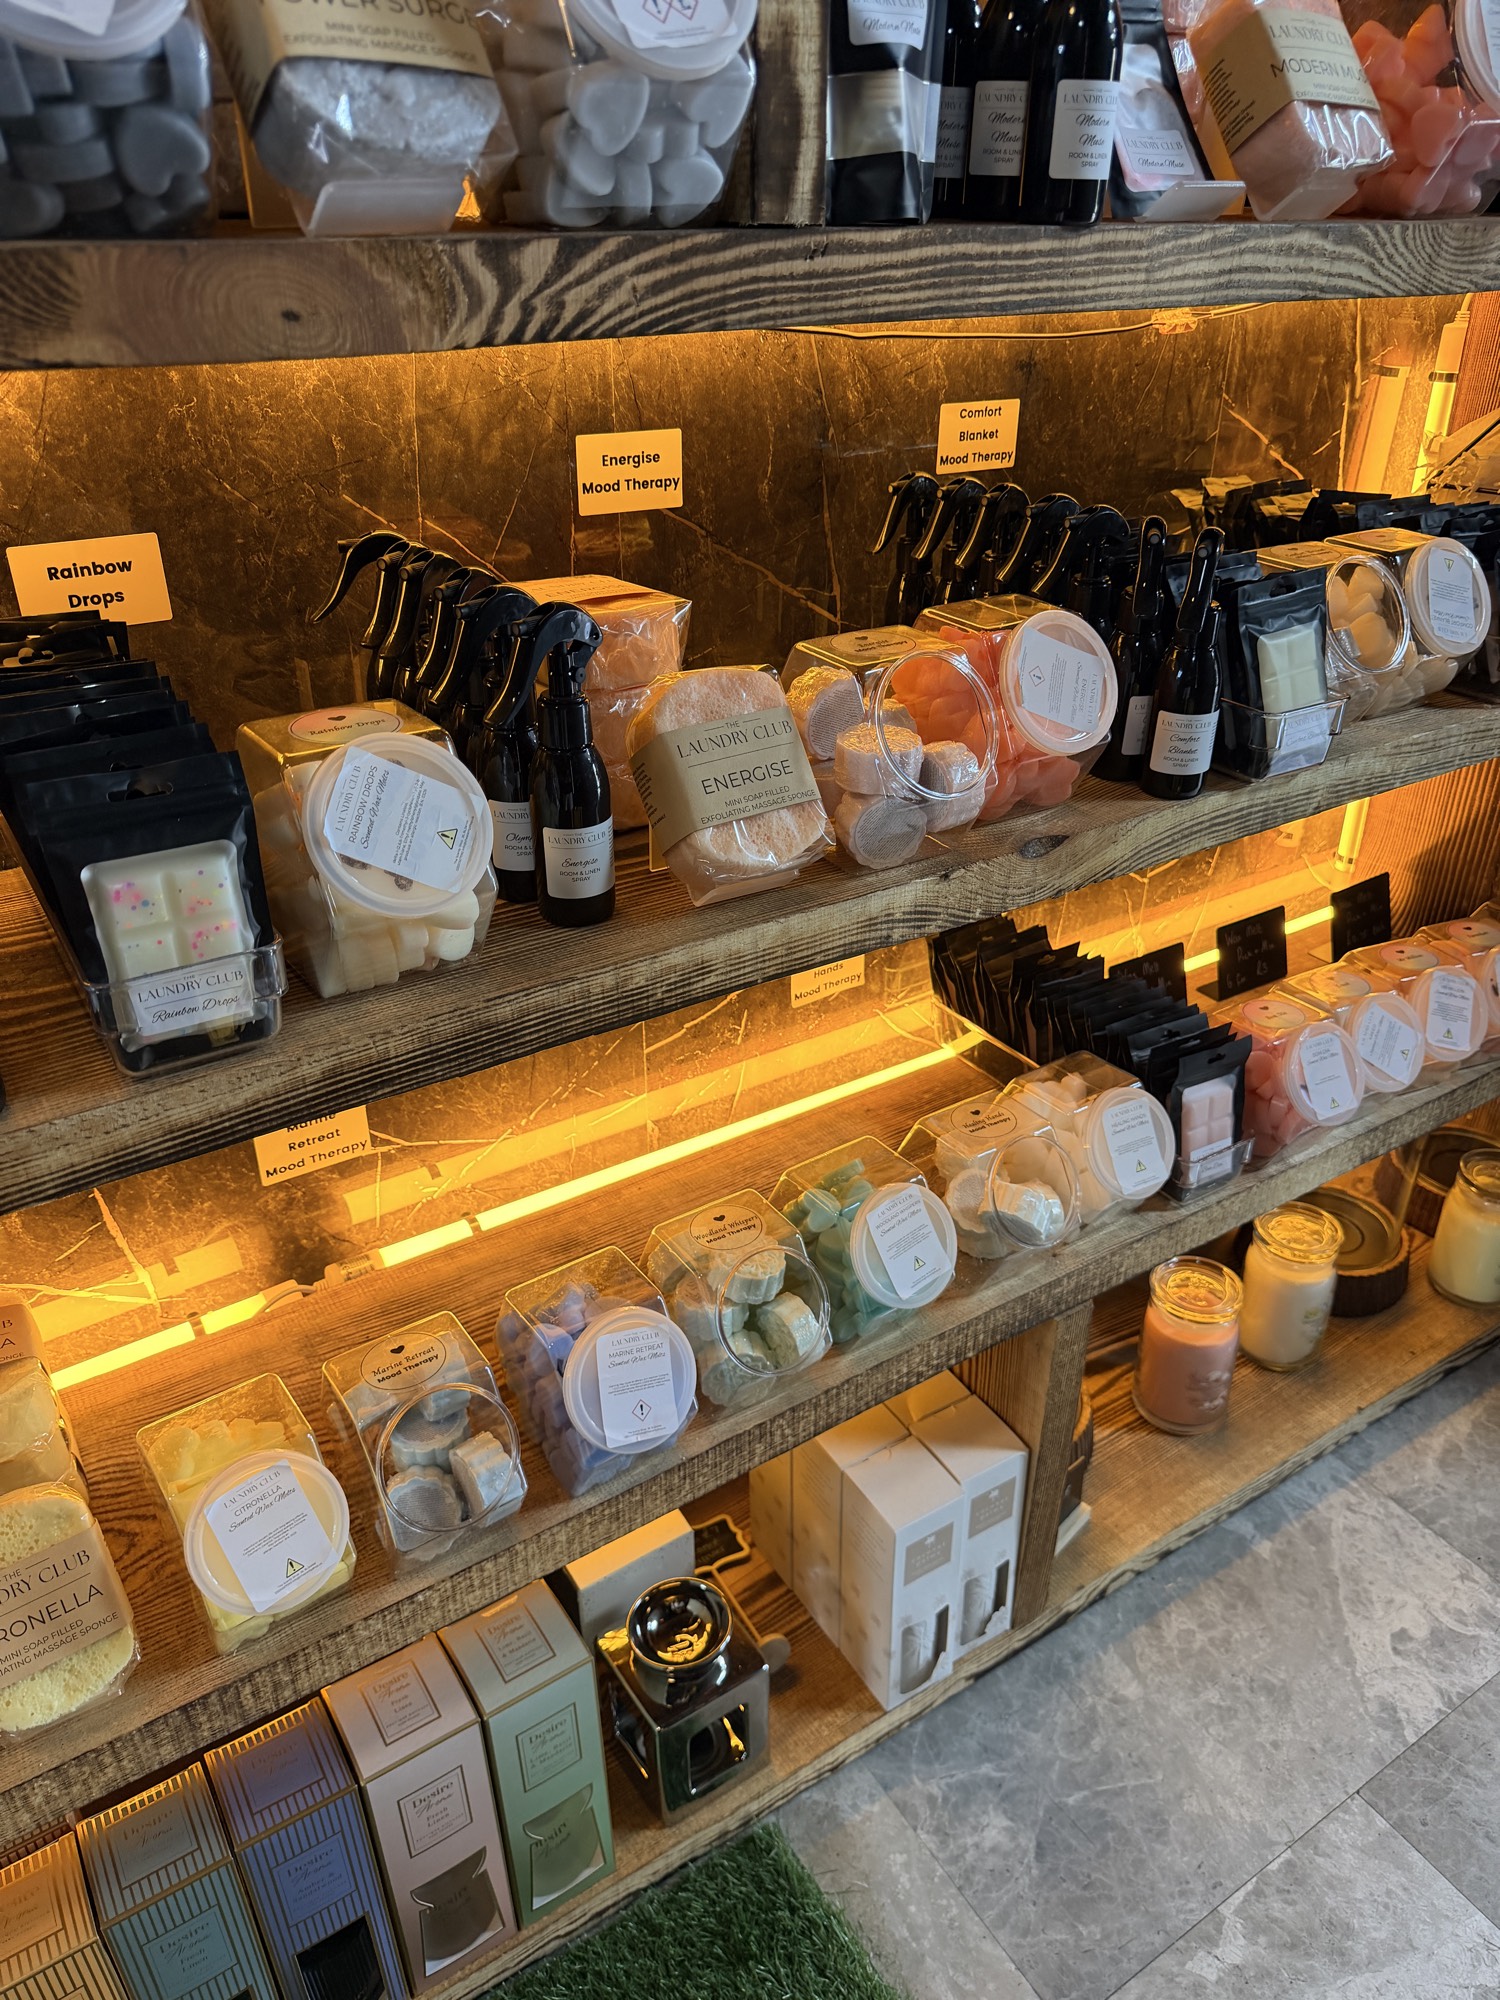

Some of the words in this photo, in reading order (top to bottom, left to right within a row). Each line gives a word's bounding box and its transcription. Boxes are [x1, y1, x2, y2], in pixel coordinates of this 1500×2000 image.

[1270, 58, 1339, 78] MODERN
[960, 406, 1002, 418] Comfort
[959, 429, 998, 441] Blanket
[602, 451, 660, 468] Energise
[940, 453, 968, 466] Mood
[972, 450, 1013, 463] Therapy
[582, 479, 620, 495] Mood
[624, 477, 680, 492] Therapy
[47, 560, 132, 581] Rainbow
[68, 591, 125, 608] Drops
[308, 723, 355, 736] Rainbow
[356, 718, 386, 730] Drops
[725, 720, 740, 729] THE
[677, 729, 749, 758] LAUNDRY
[752, 720, 793, 740] CLUB
[701, 759, 793, 795] ENERGISE
[336, 791, 353, 831] LAUNDRY
[348, 765, 362, 790] CLUB
[349, 798, 367, 843] RAINBOW
[363, 765, 378, 797] DROPS
[701, 805, 751, 825] EXFOLIATING
[751, 798, 787, 811] MASSAGE
[787, 789, 816, 803] SPONGE
[725, 798, 743, 808] MINI
[744, 791, 764, 804] SOAP
[765, 785, 790, 798] FILLED
[362, 818, 374, 848] Scented
[370, 795, 382, 816] Wax
[548, 836, 586, 845] LAUNDRY
[561, 857, 599, 868] Energise
[813, 962, 844, 979] Hands
[137, 978, 203, 1003] LAUNDRY
[206, 970, 244, 987] CLUB
[794, 985, 821, 1000] Mood
[823, 972, 862, 991] Therapy
[151, 1005, 200, 1024] Rainbow
[202, 995, 241, 1013] Drops
[288, 1128, 341, 1151] Retreat
[265, 1158, 305, 1178] Mood
[309, 1140, 368, 1163] Therapy
[694, 1225, 728, 1242] Woodland
[706, 1233, 726, 1244] Mood
[727, 1223, 757, 1237] Therapy
[372, 1360, 403, 1377] Marine
[405, 1345, 435, 1363] Retreat
[608, 1349, 635, 1359] MARINE
[635, 1342, 664, 1354] RETREAT
[376, 1369, 402, 1384] Mood
[402, 1353, 439, 1372] Therapy
[234, 1485, 283, 1517] CITRONELLA
[4, 1569, 22, 1582] THE
[38, 1549, 90, 1583] CLUB
[0, 1584, 104, 1643] RONELLA
[0, 1649, 22, 1665] MINI
[23, 1635, 49, 1653] SOAP
[51, 1619, 84, 1640] FILLED
[33, 1634, 79, 1659] MASSAGE
[80, 1611, 119, 1637] SPONGE
